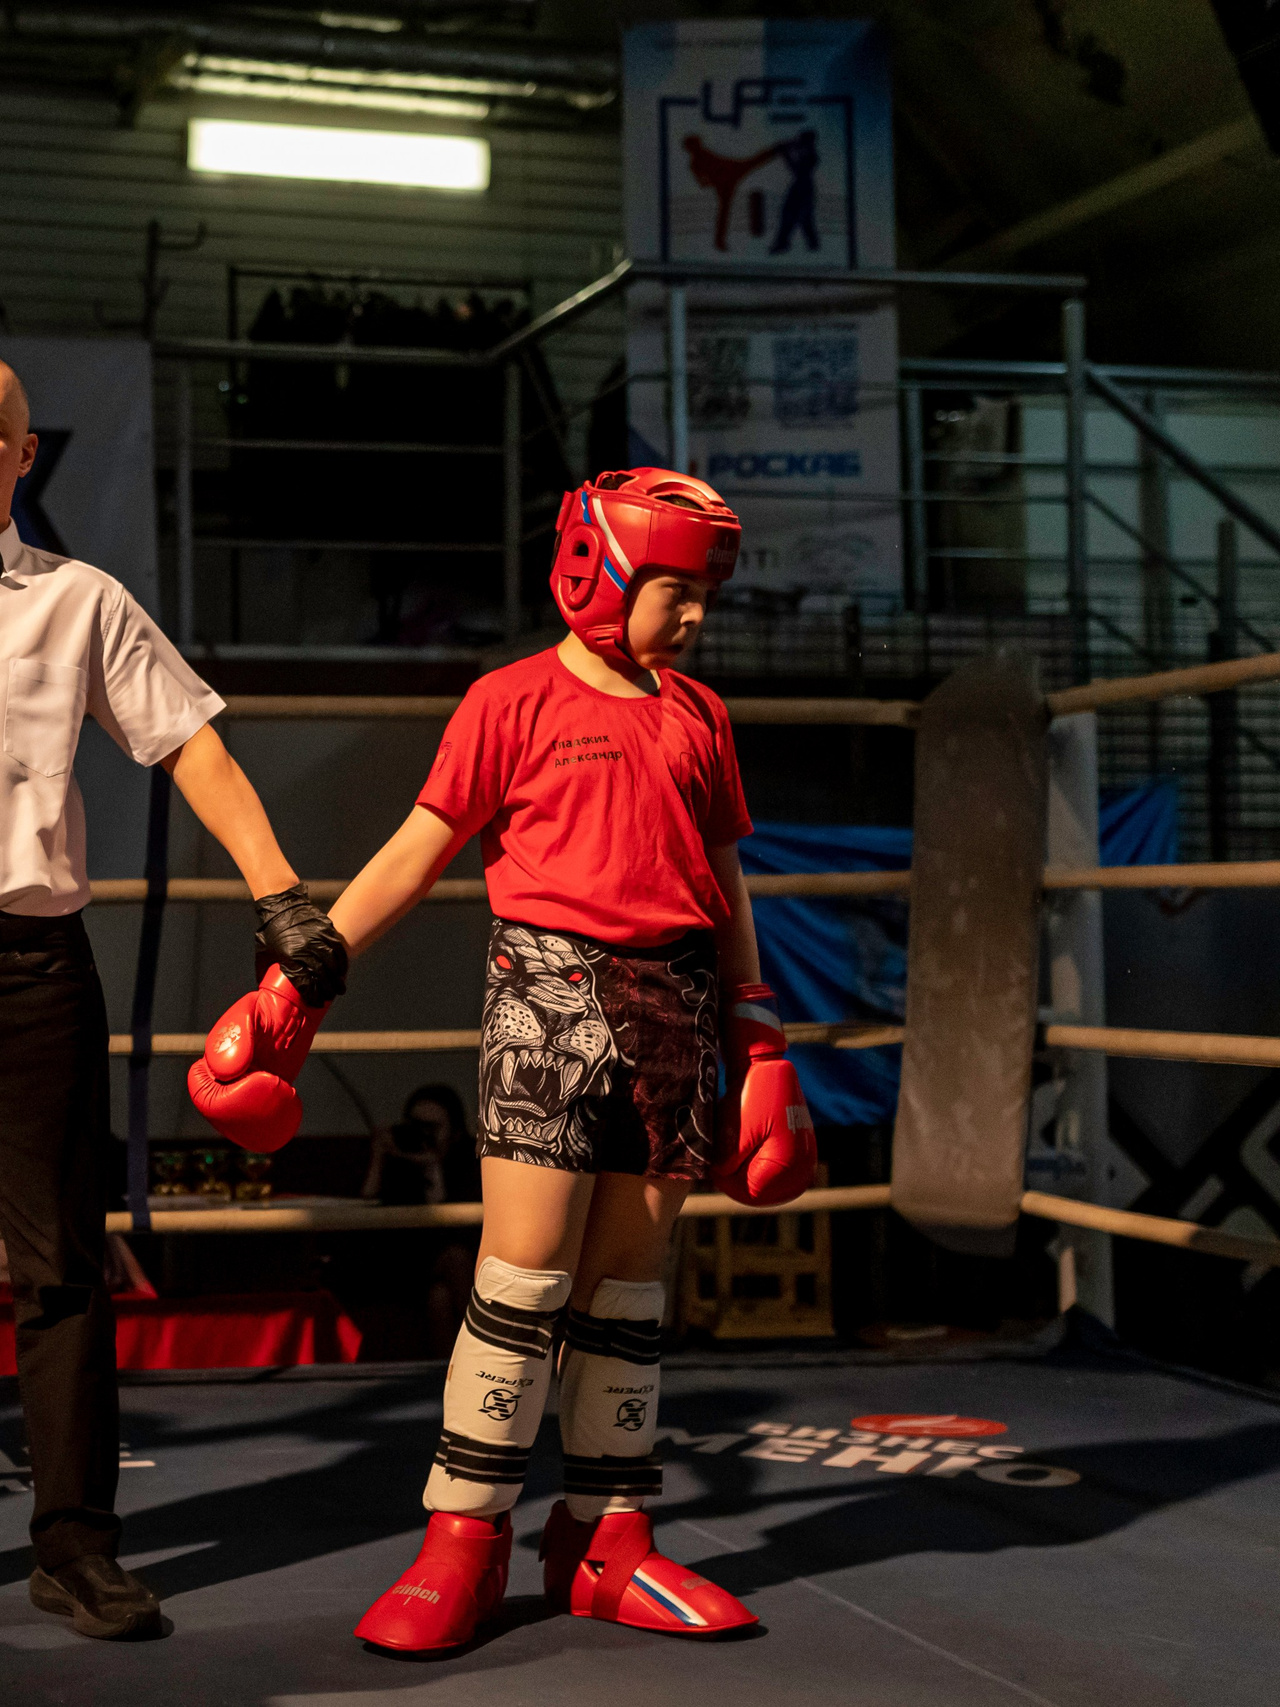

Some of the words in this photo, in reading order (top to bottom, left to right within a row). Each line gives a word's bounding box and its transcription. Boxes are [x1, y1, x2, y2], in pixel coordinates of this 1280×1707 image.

[551, 734, 610, 751] Гладских
[554, 750, 623, 768] Александр
[747, 1421, 1025, 1460] БИЗНЕС
[654, 1425, 1082, 1488] МЕНЮ
[392, 1582, 441, 1605] clinch
